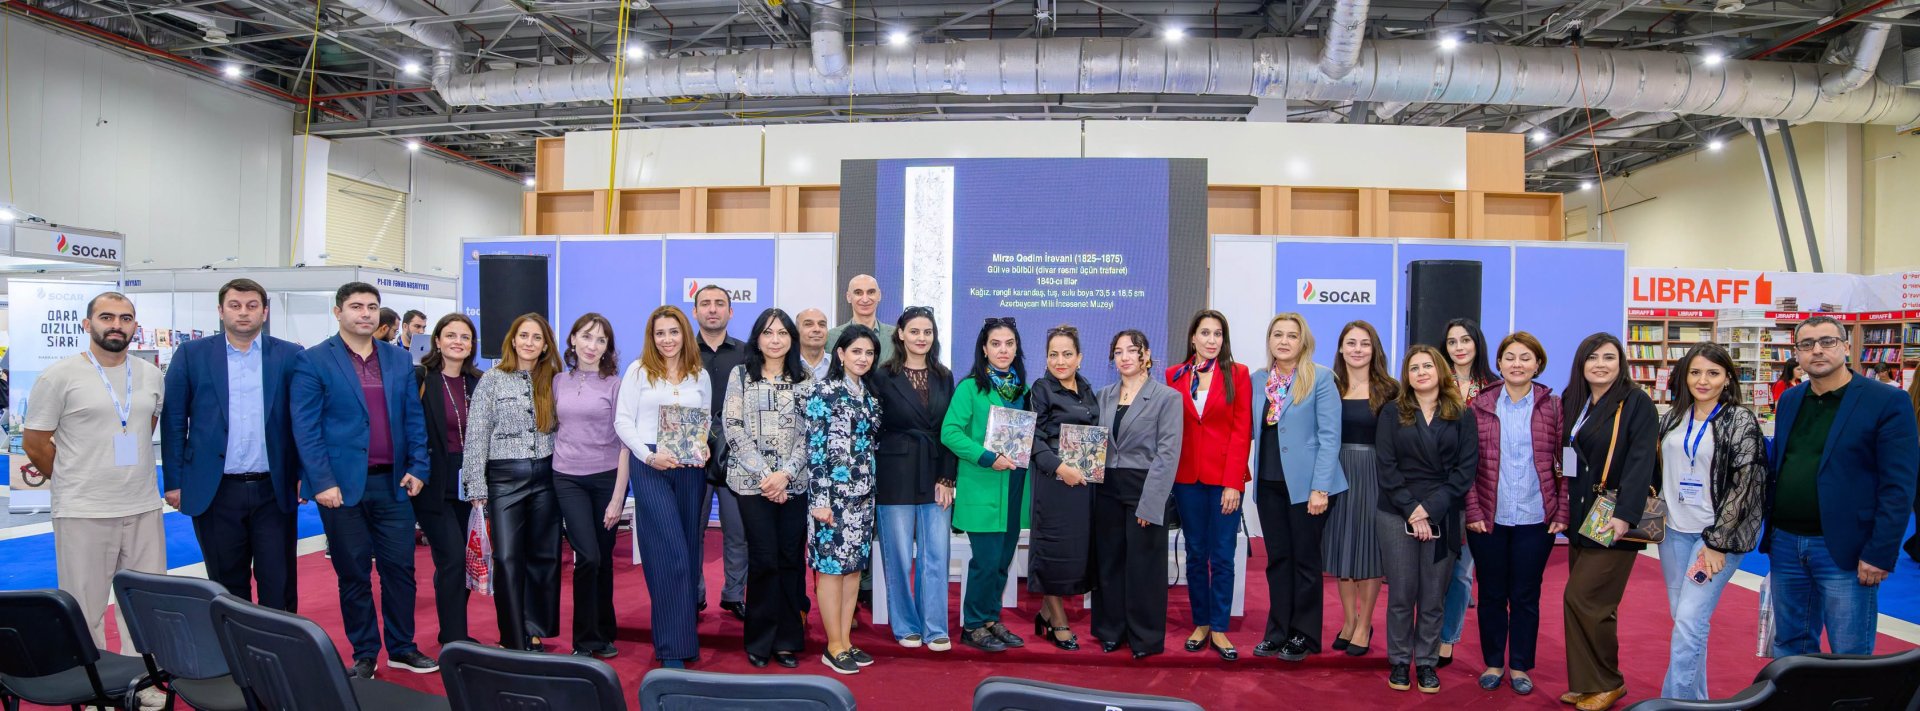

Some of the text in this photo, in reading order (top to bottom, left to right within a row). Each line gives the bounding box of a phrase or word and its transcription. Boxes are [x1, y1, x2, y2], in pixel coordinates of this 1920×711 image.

[72, 245, 116, 259] SOCAR
[992, 254, 1015, 263] Mirzə
[1016, 254, 1043, 263] Qədim
[1044, 252, 1072, 263] İrəvani
[987, 266, 1000, 274] Gül
[1012, 266, 1034, 274] bülbül
[1035, 266, 1056, 276] (divar
[1058, 266, 1078, 274] rəsmi
[1080, 266, 1098, 276] üçün
[993, 288, 1012, 298] rəngli
[1077, 289, 1094, 298] boya
[1633, 276, 1750, 305] LIBRAFF
[48, 293, 84, 301] SOCAR
[1319, 291, 1371, 303] SOCAR
[999, 299, 1040, 309] Azərbaycan
[47, 309, 78, 322] QARA
[41, 322, 85, 335] QIZILIN
